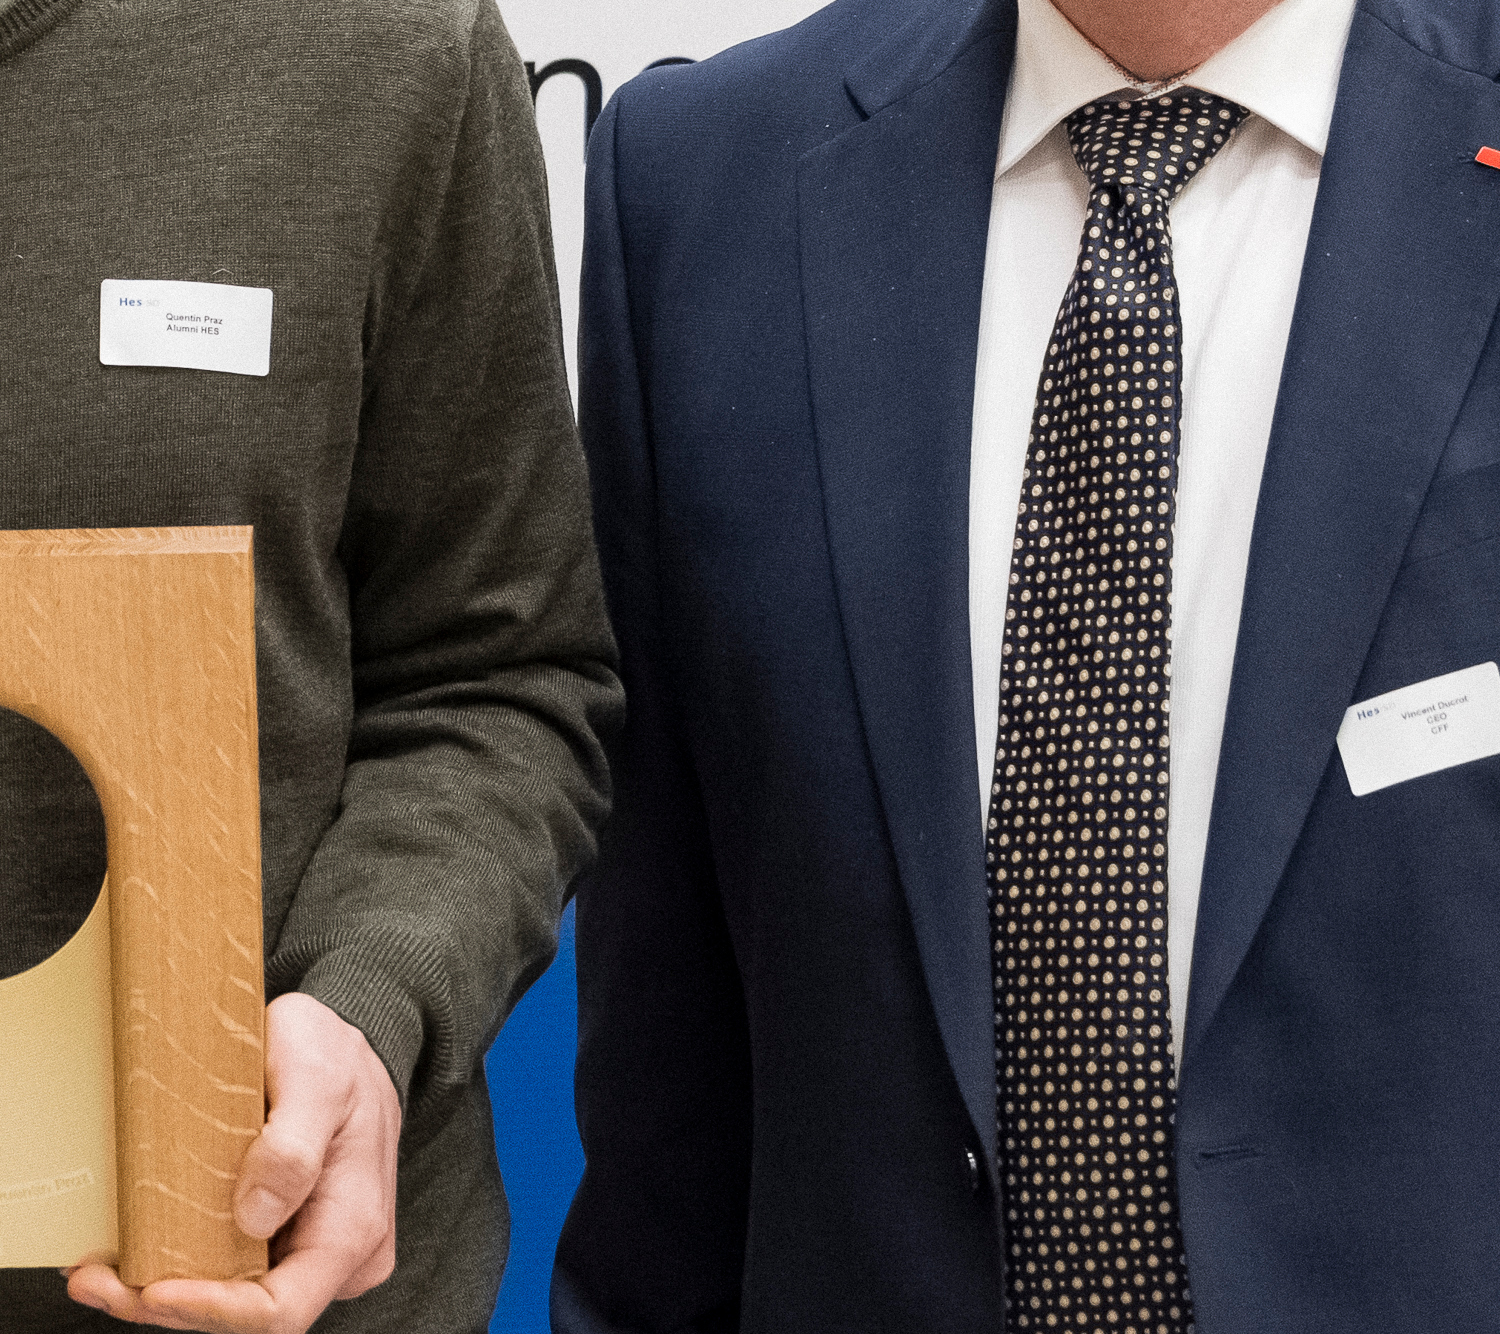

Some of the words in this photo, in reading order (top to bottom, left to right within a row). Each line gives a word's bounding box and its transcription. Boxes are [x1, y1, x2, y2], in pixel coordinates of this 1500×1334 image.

[165, 312, 202, 323] Quentin
[204, 315, 223, 325] Praz
[166, 324, 199, 334] Alumni
[200, 326, 220, 336] HES
[1400, 703, 1436, 721] Vincent
[1437, 695, 1469, 710] Ducrot
[1426, 712, 1448, 724] CEO
